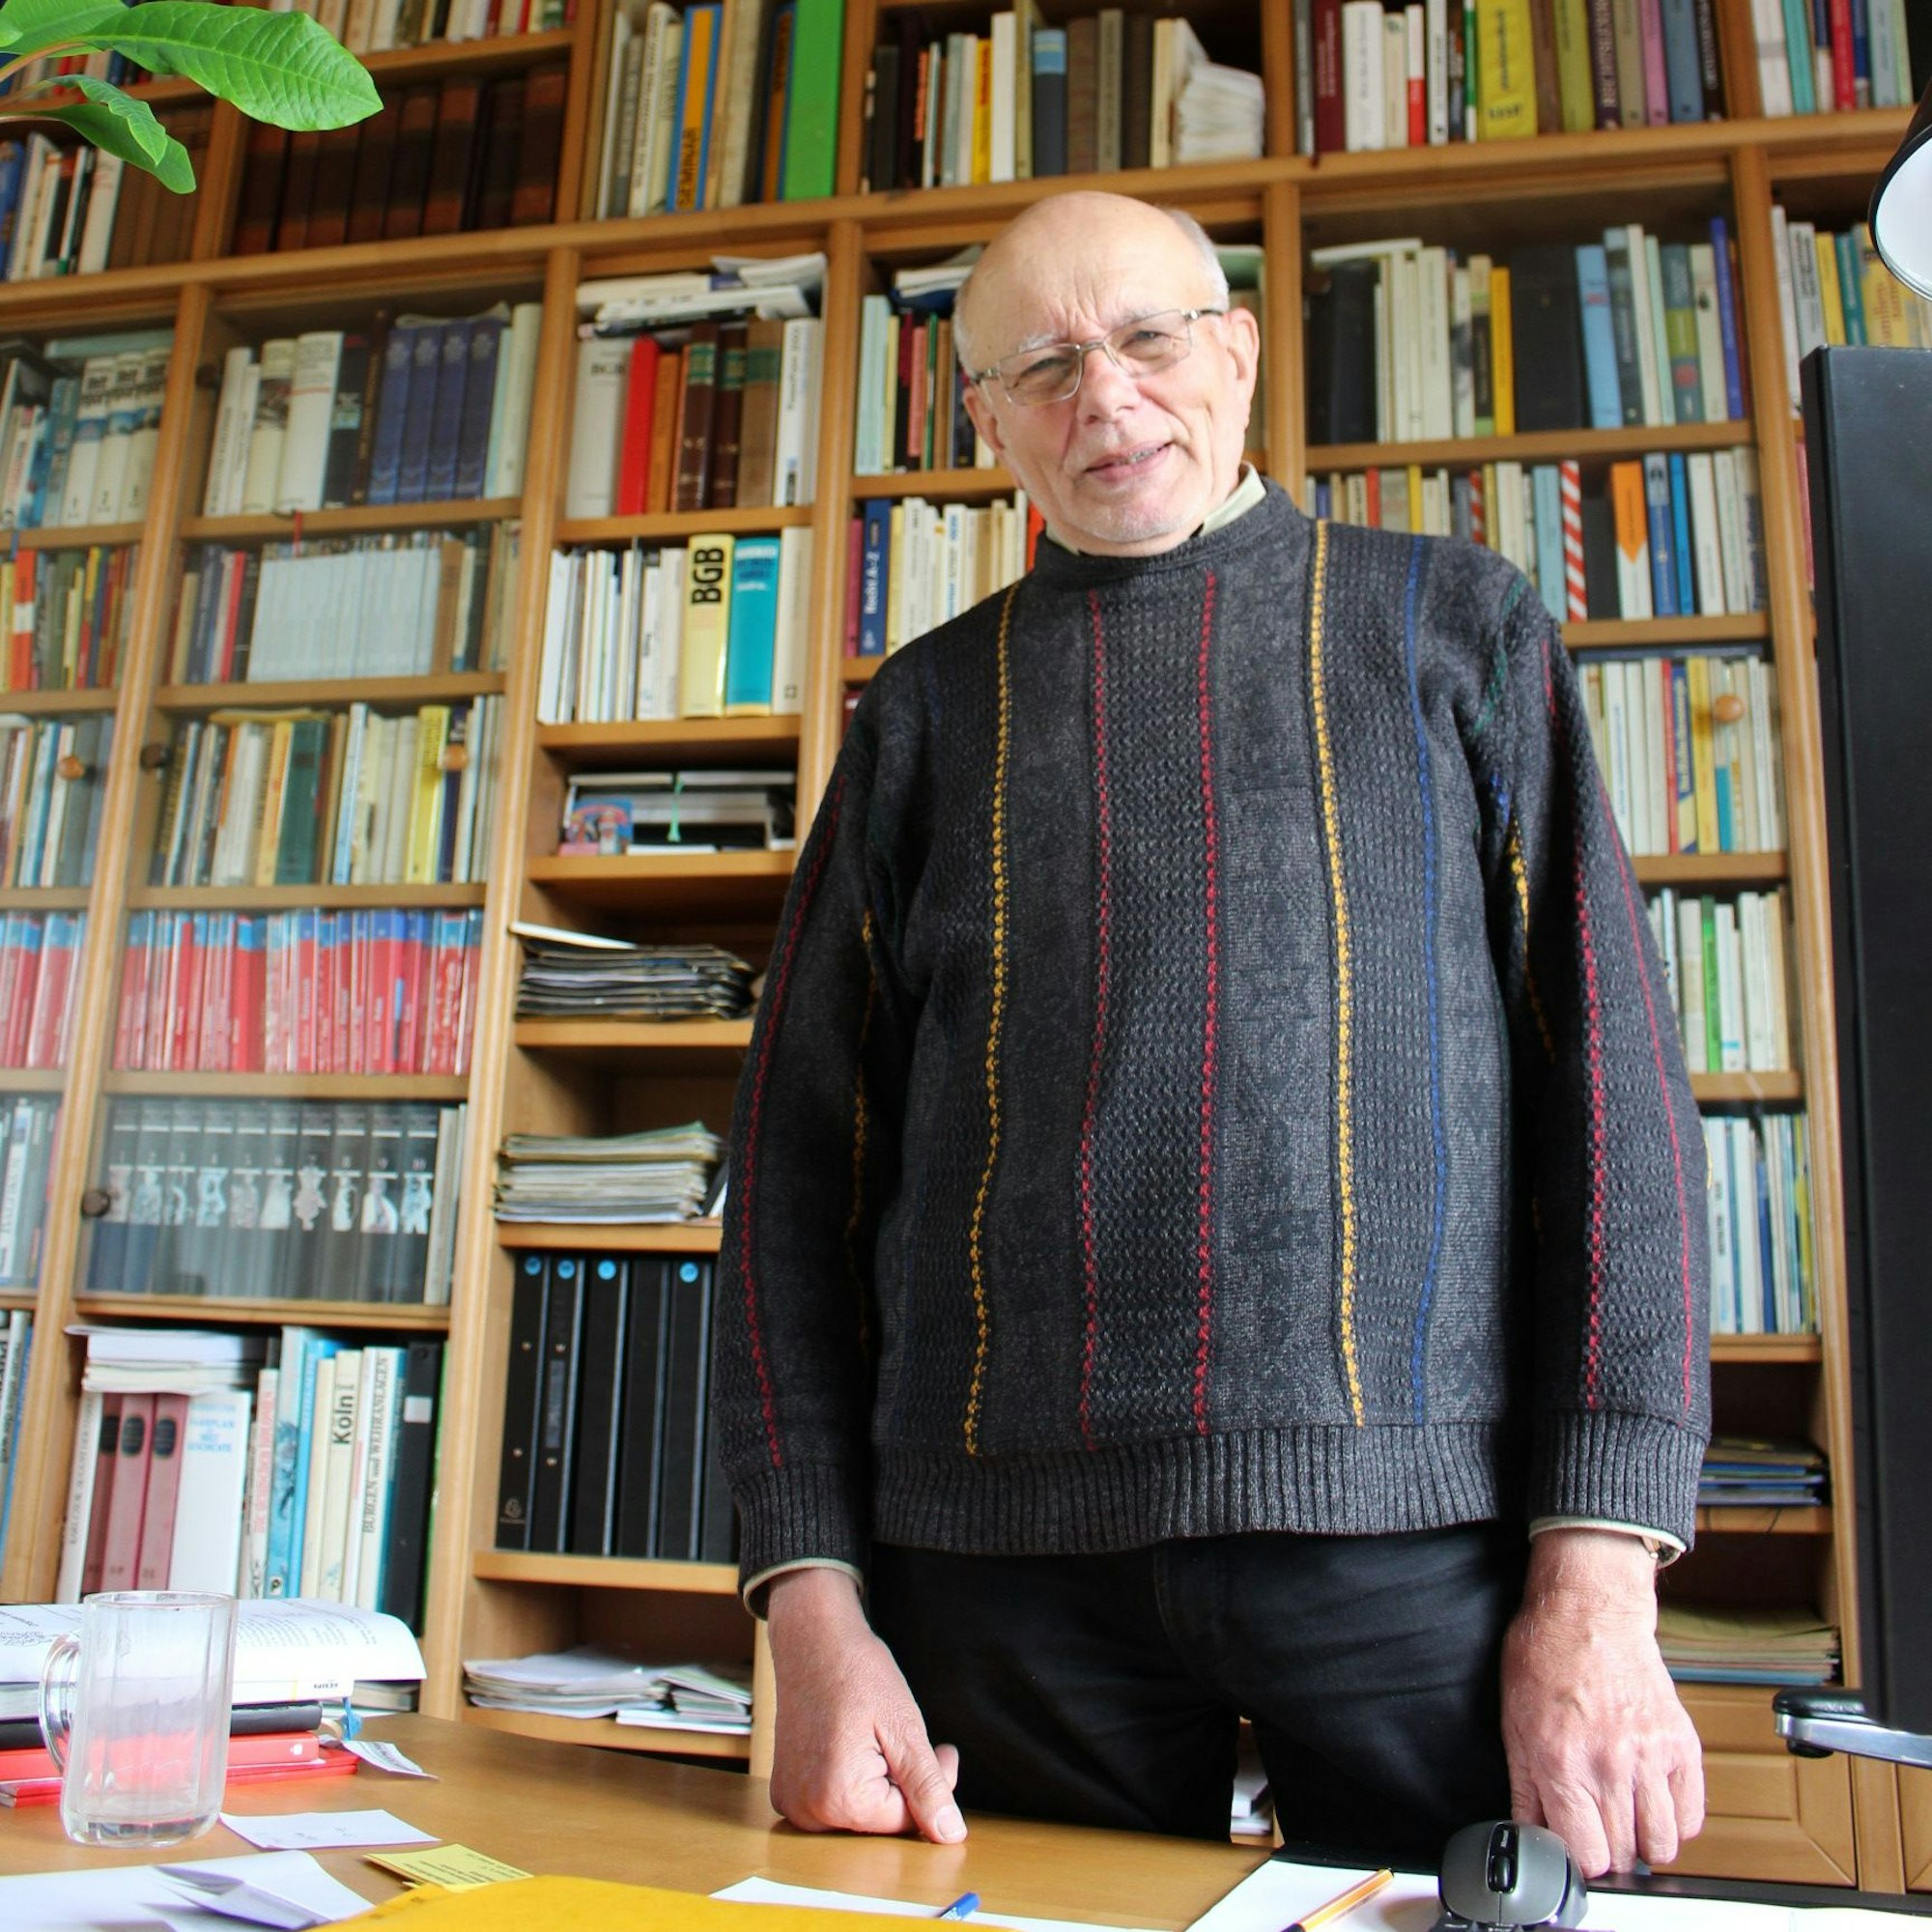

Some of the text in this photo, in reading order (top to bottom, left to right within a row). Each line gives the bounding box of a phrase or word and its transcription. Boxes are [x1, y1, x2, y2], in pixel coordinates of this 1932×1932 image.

[691, 548, 724, 604] BGB
[333, 1395, 355, 1444] Köln
[362, 1481, 378, 1533] BURGEN
[371, 1455, 383, 1478] und
